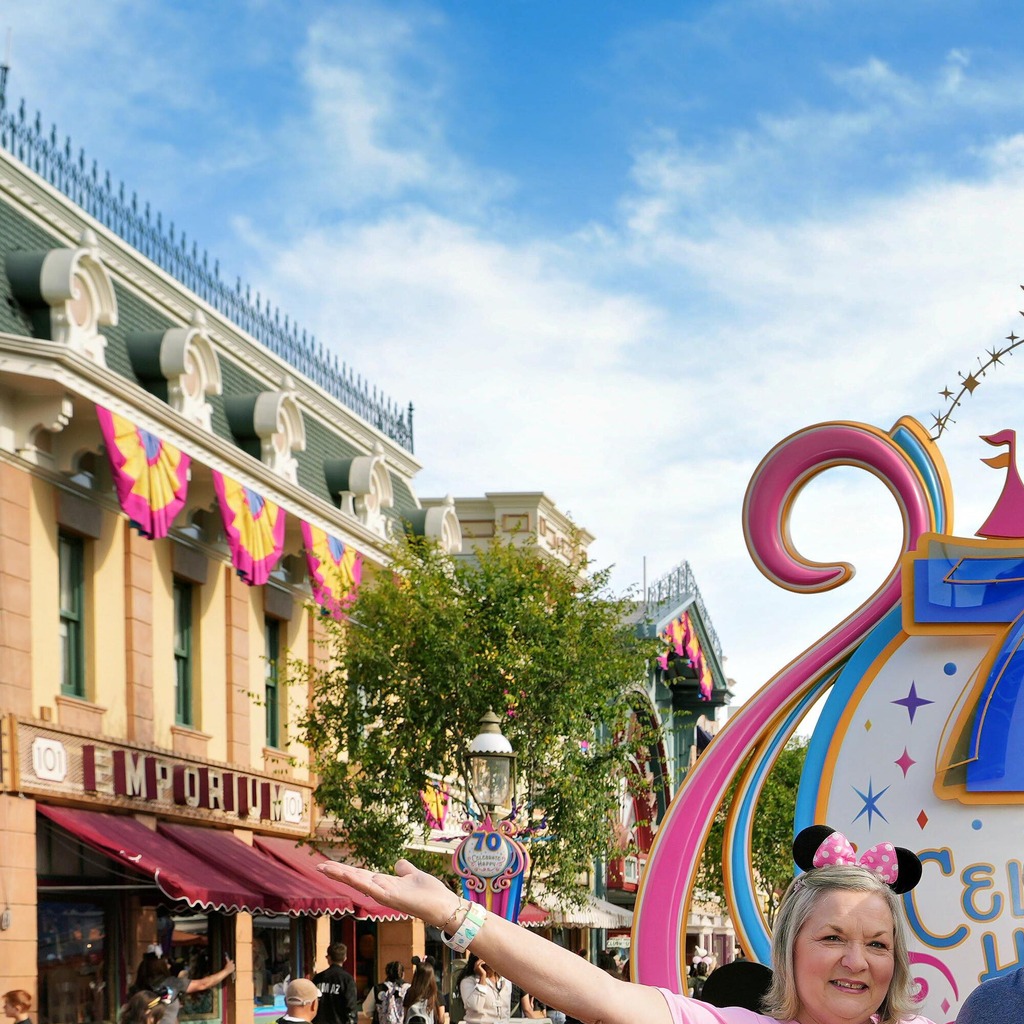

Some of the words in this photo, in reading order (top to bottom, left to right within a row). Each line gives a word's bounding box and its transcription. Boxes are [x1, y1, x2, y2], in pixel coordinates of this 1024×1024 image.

[37, 746, 64, 775] 101
[82, 745, 284, 822] EMPORIUM
[472, 832, 502, 851] 70
